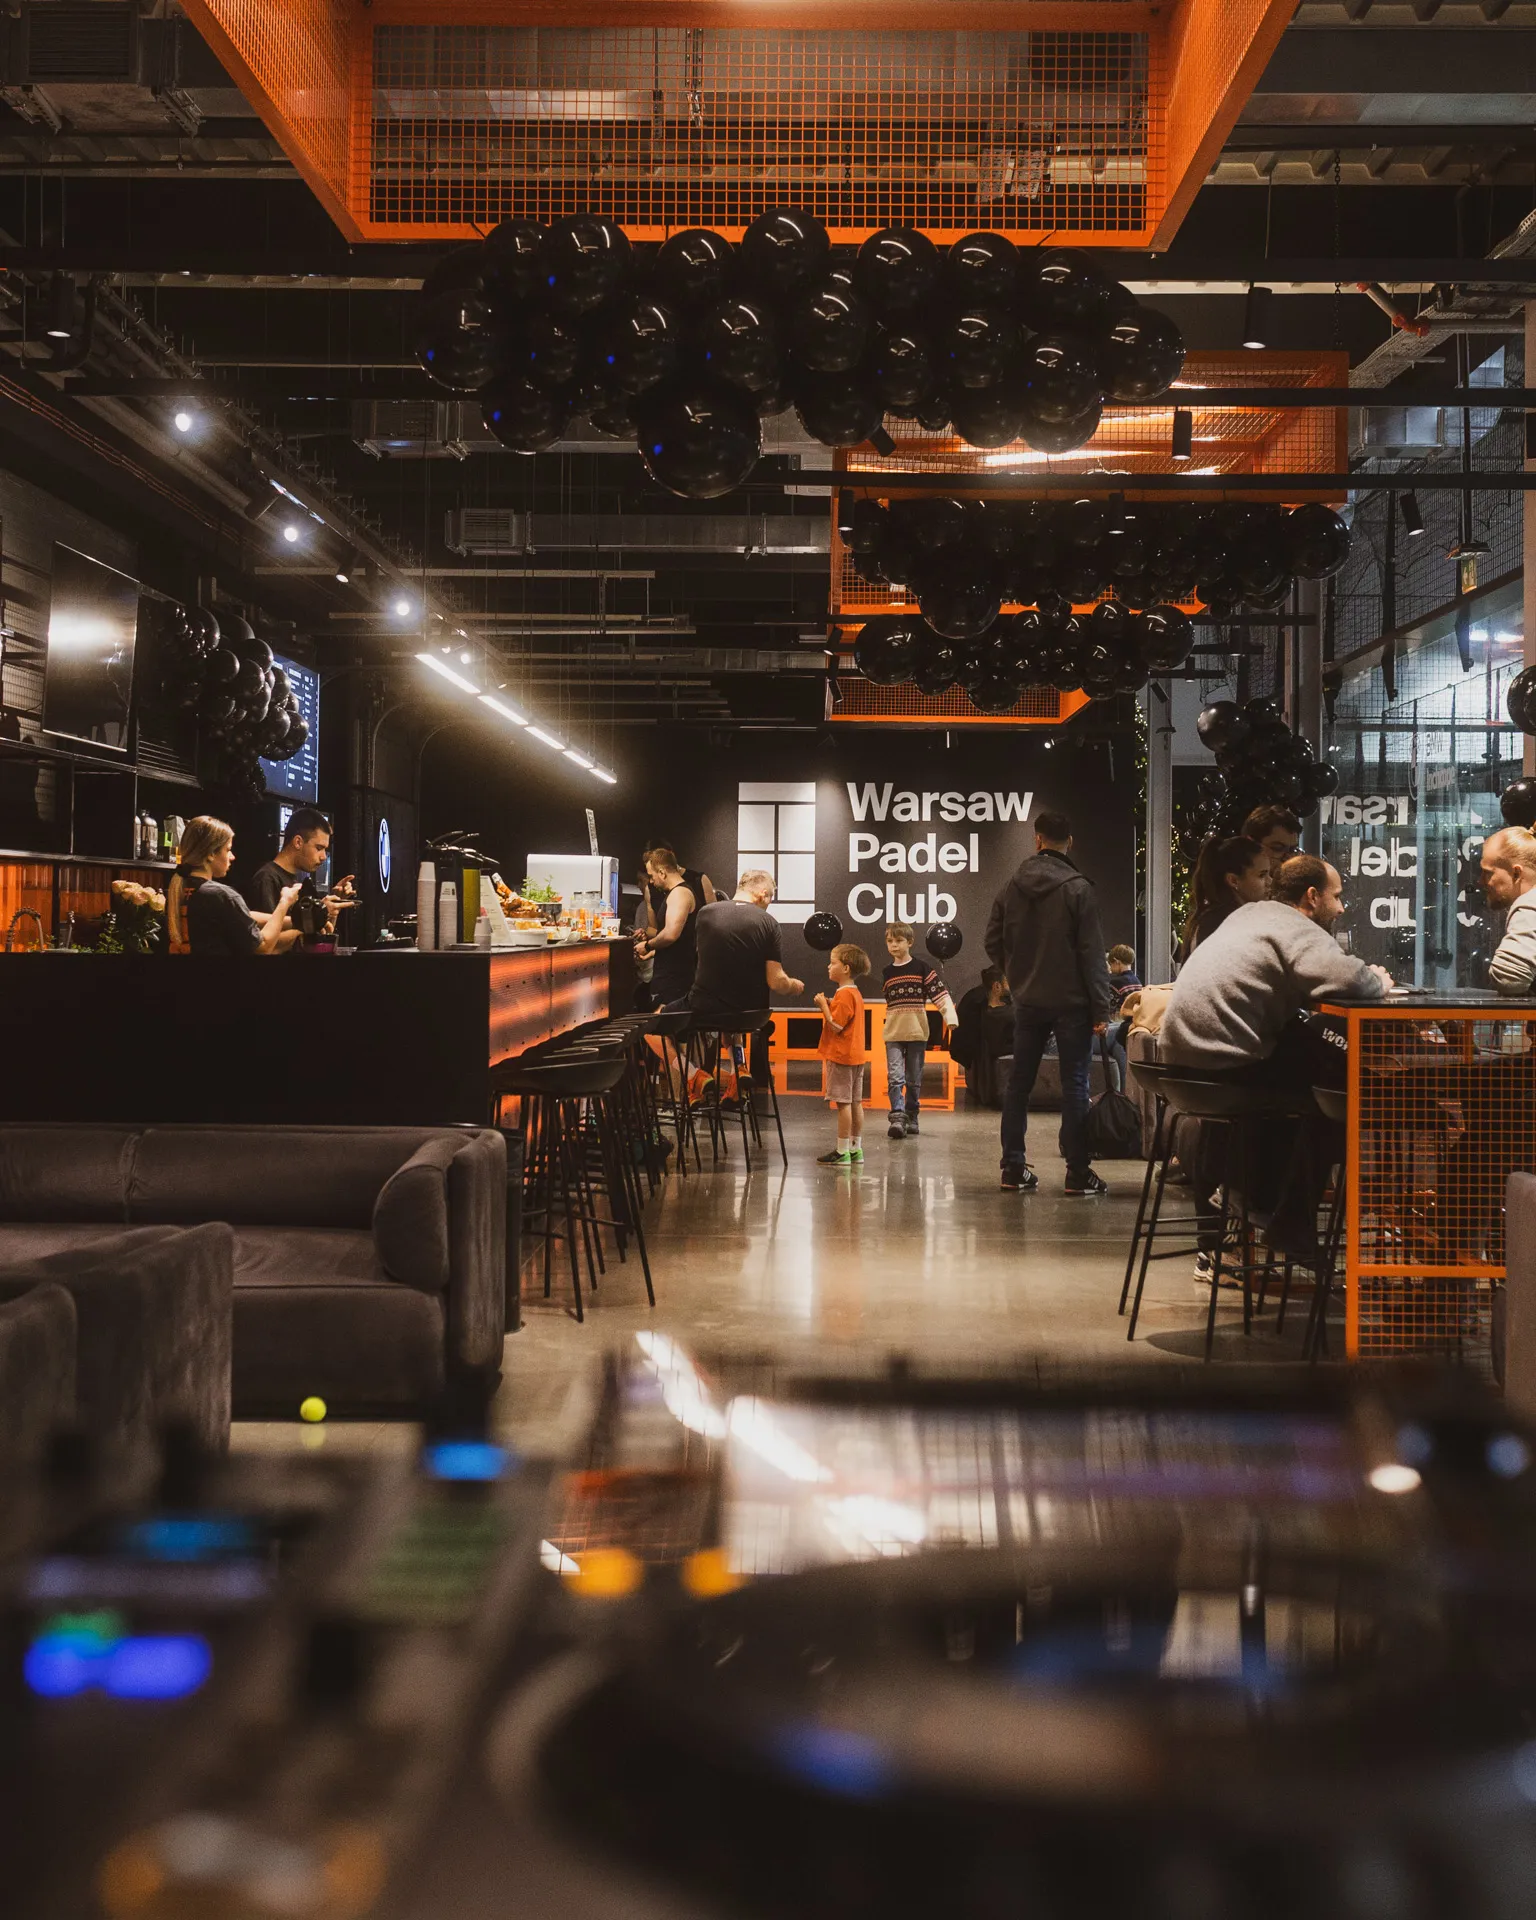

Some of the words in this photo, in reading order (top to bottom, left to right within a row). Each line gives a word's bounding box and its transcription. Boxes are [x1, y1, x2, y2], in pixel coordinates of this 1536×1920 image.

[847, 782, 1033, 822] Warsaw
[849, 832, 979, 873] Padel
[847, 883, 957, 923] Club
